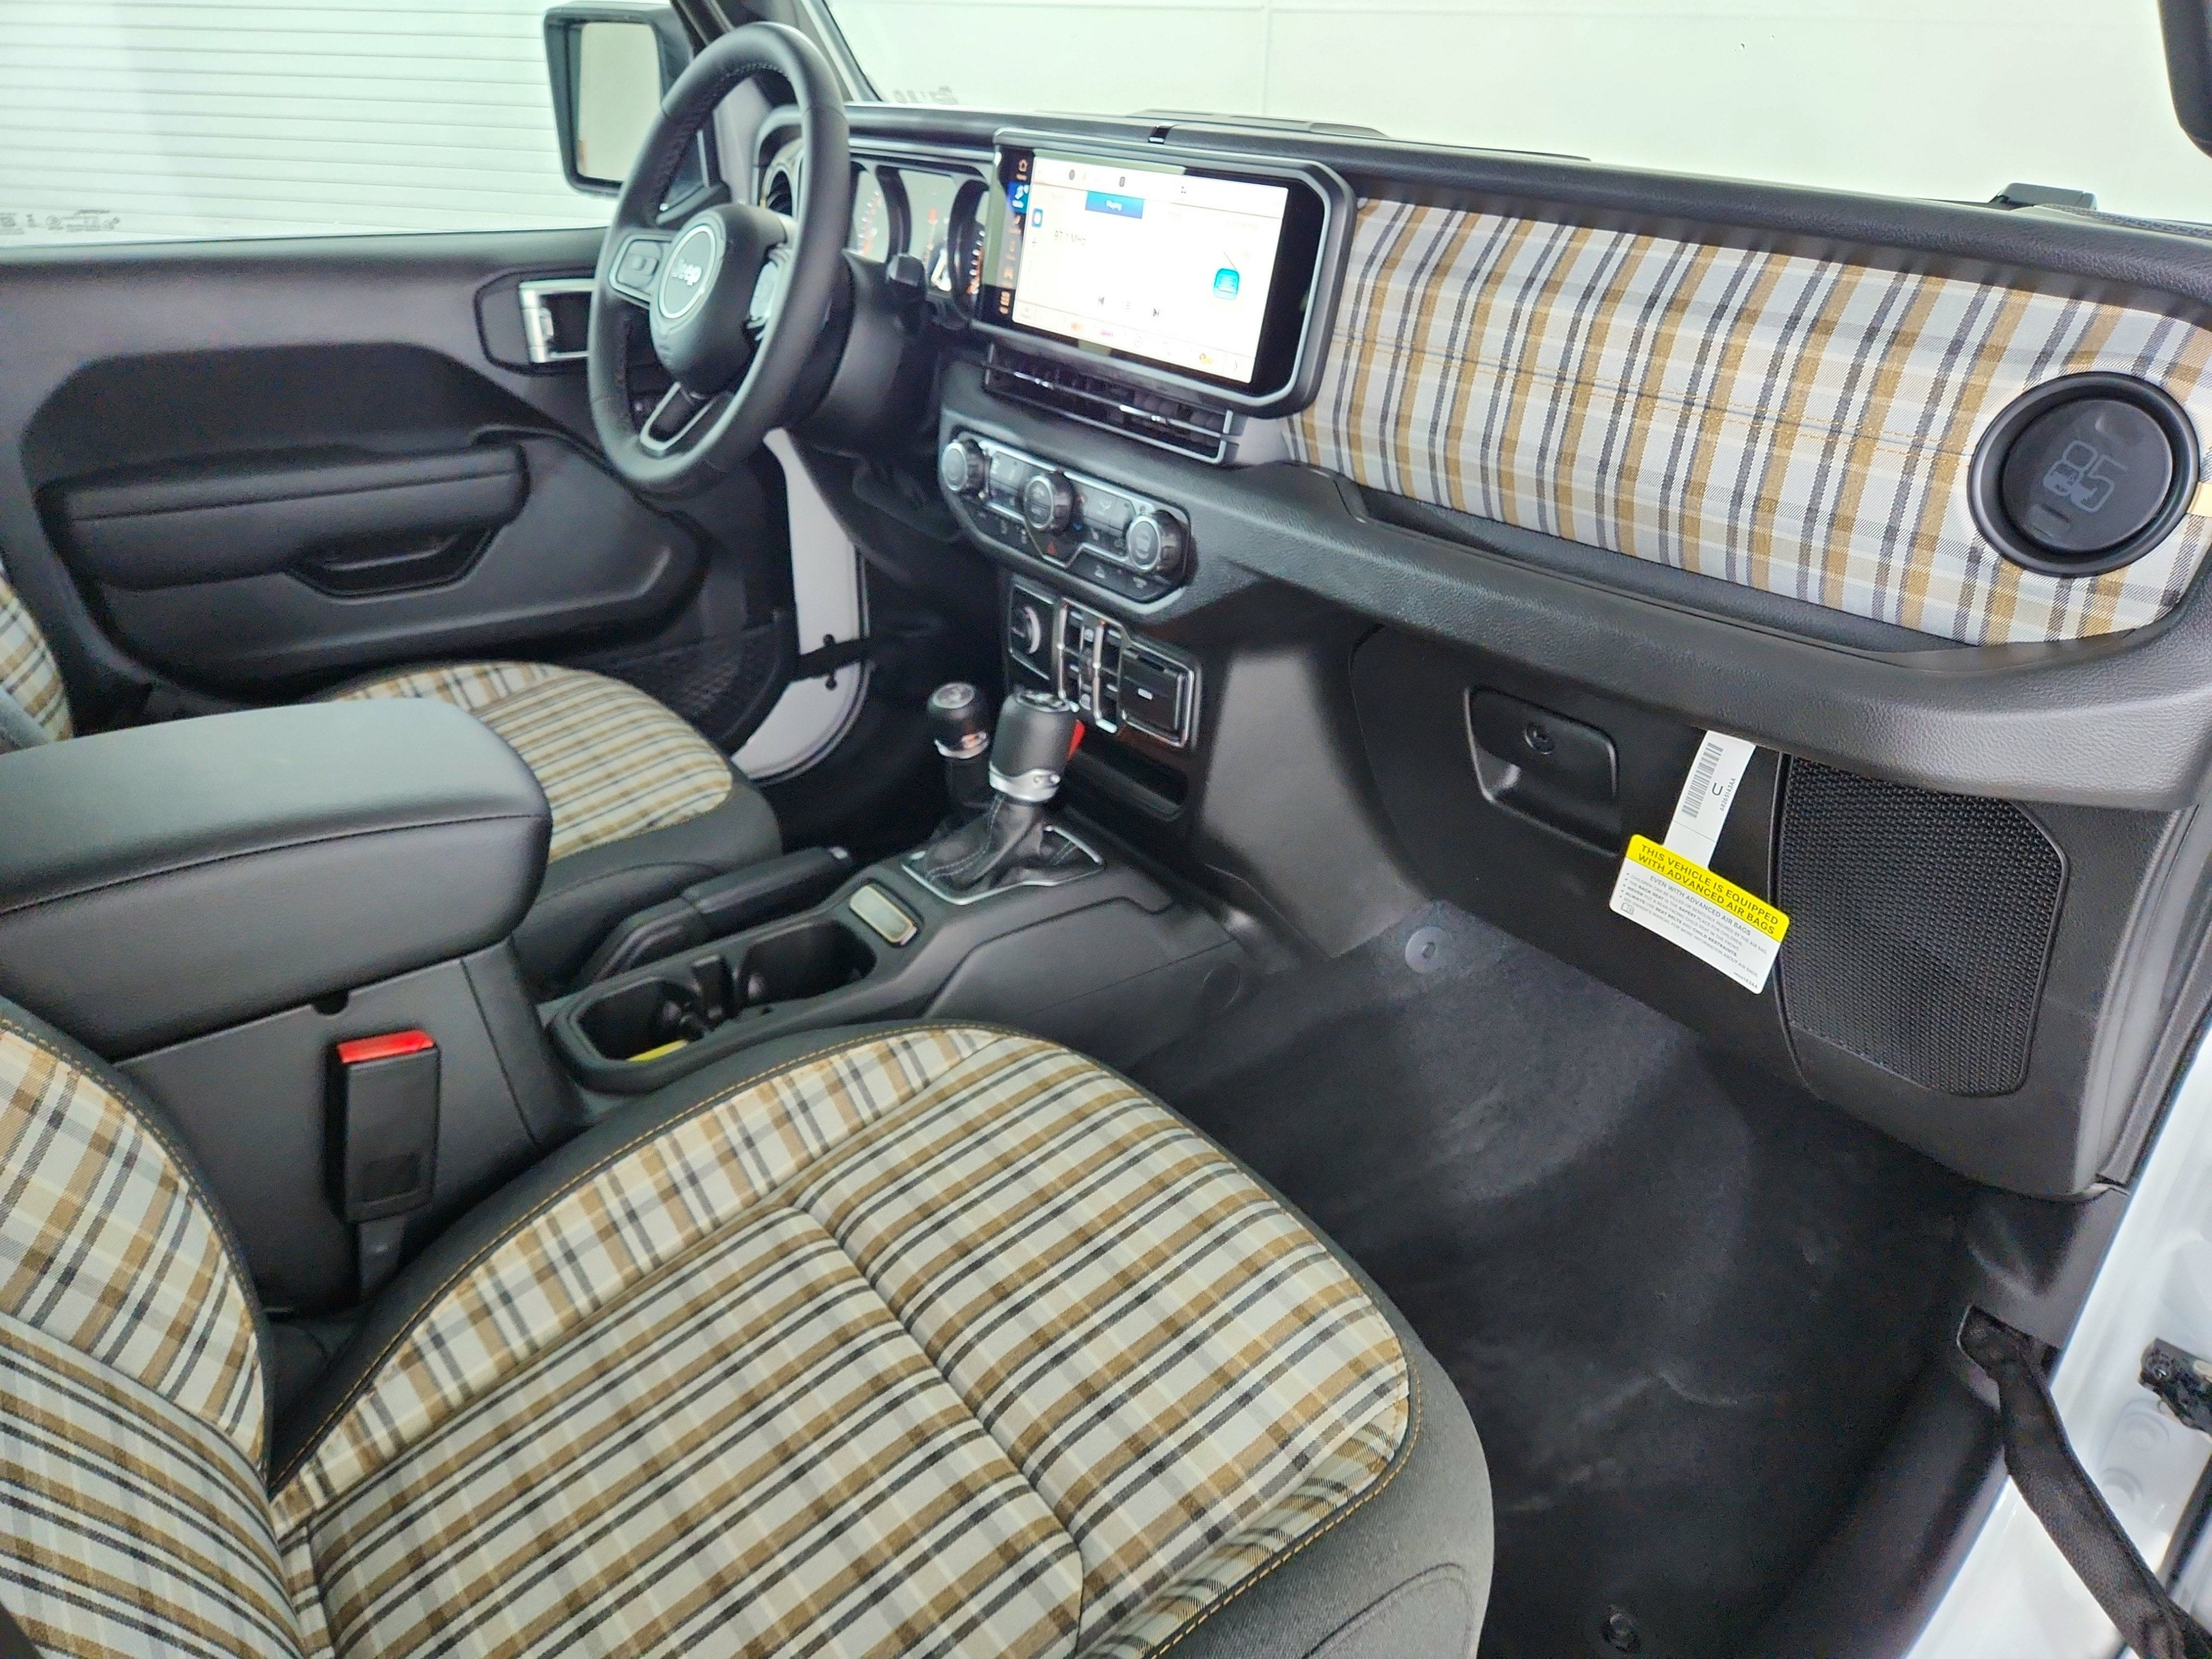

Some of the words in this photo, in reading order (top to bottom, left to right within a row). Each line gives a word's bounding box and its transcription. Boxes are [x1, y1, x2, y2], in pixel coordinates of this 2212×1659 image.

[1637, 853, 1665, 872] WITH
[1667, 868, 1725, 905] ADVANCED
[1726, 901, 1745, 916] AIR
[1746, 912, 1775, 935] BAGS
[1640, 844, 1665, 862] THIS
[1666, 857, 1711, 886] VEHICLE
[1713, 882, 1724, 893] IS
[1725, 889, 1779, 925] EQUIPPED
[1650, 875, 1667, 888] EVEN
[1667, 884, 1685, 898] WITH
[1685, 894, 1720, 918] ADVANCED
[1721, 915, 1733, 925] AIR
[1733, 922, 1751, 936] BAGS
